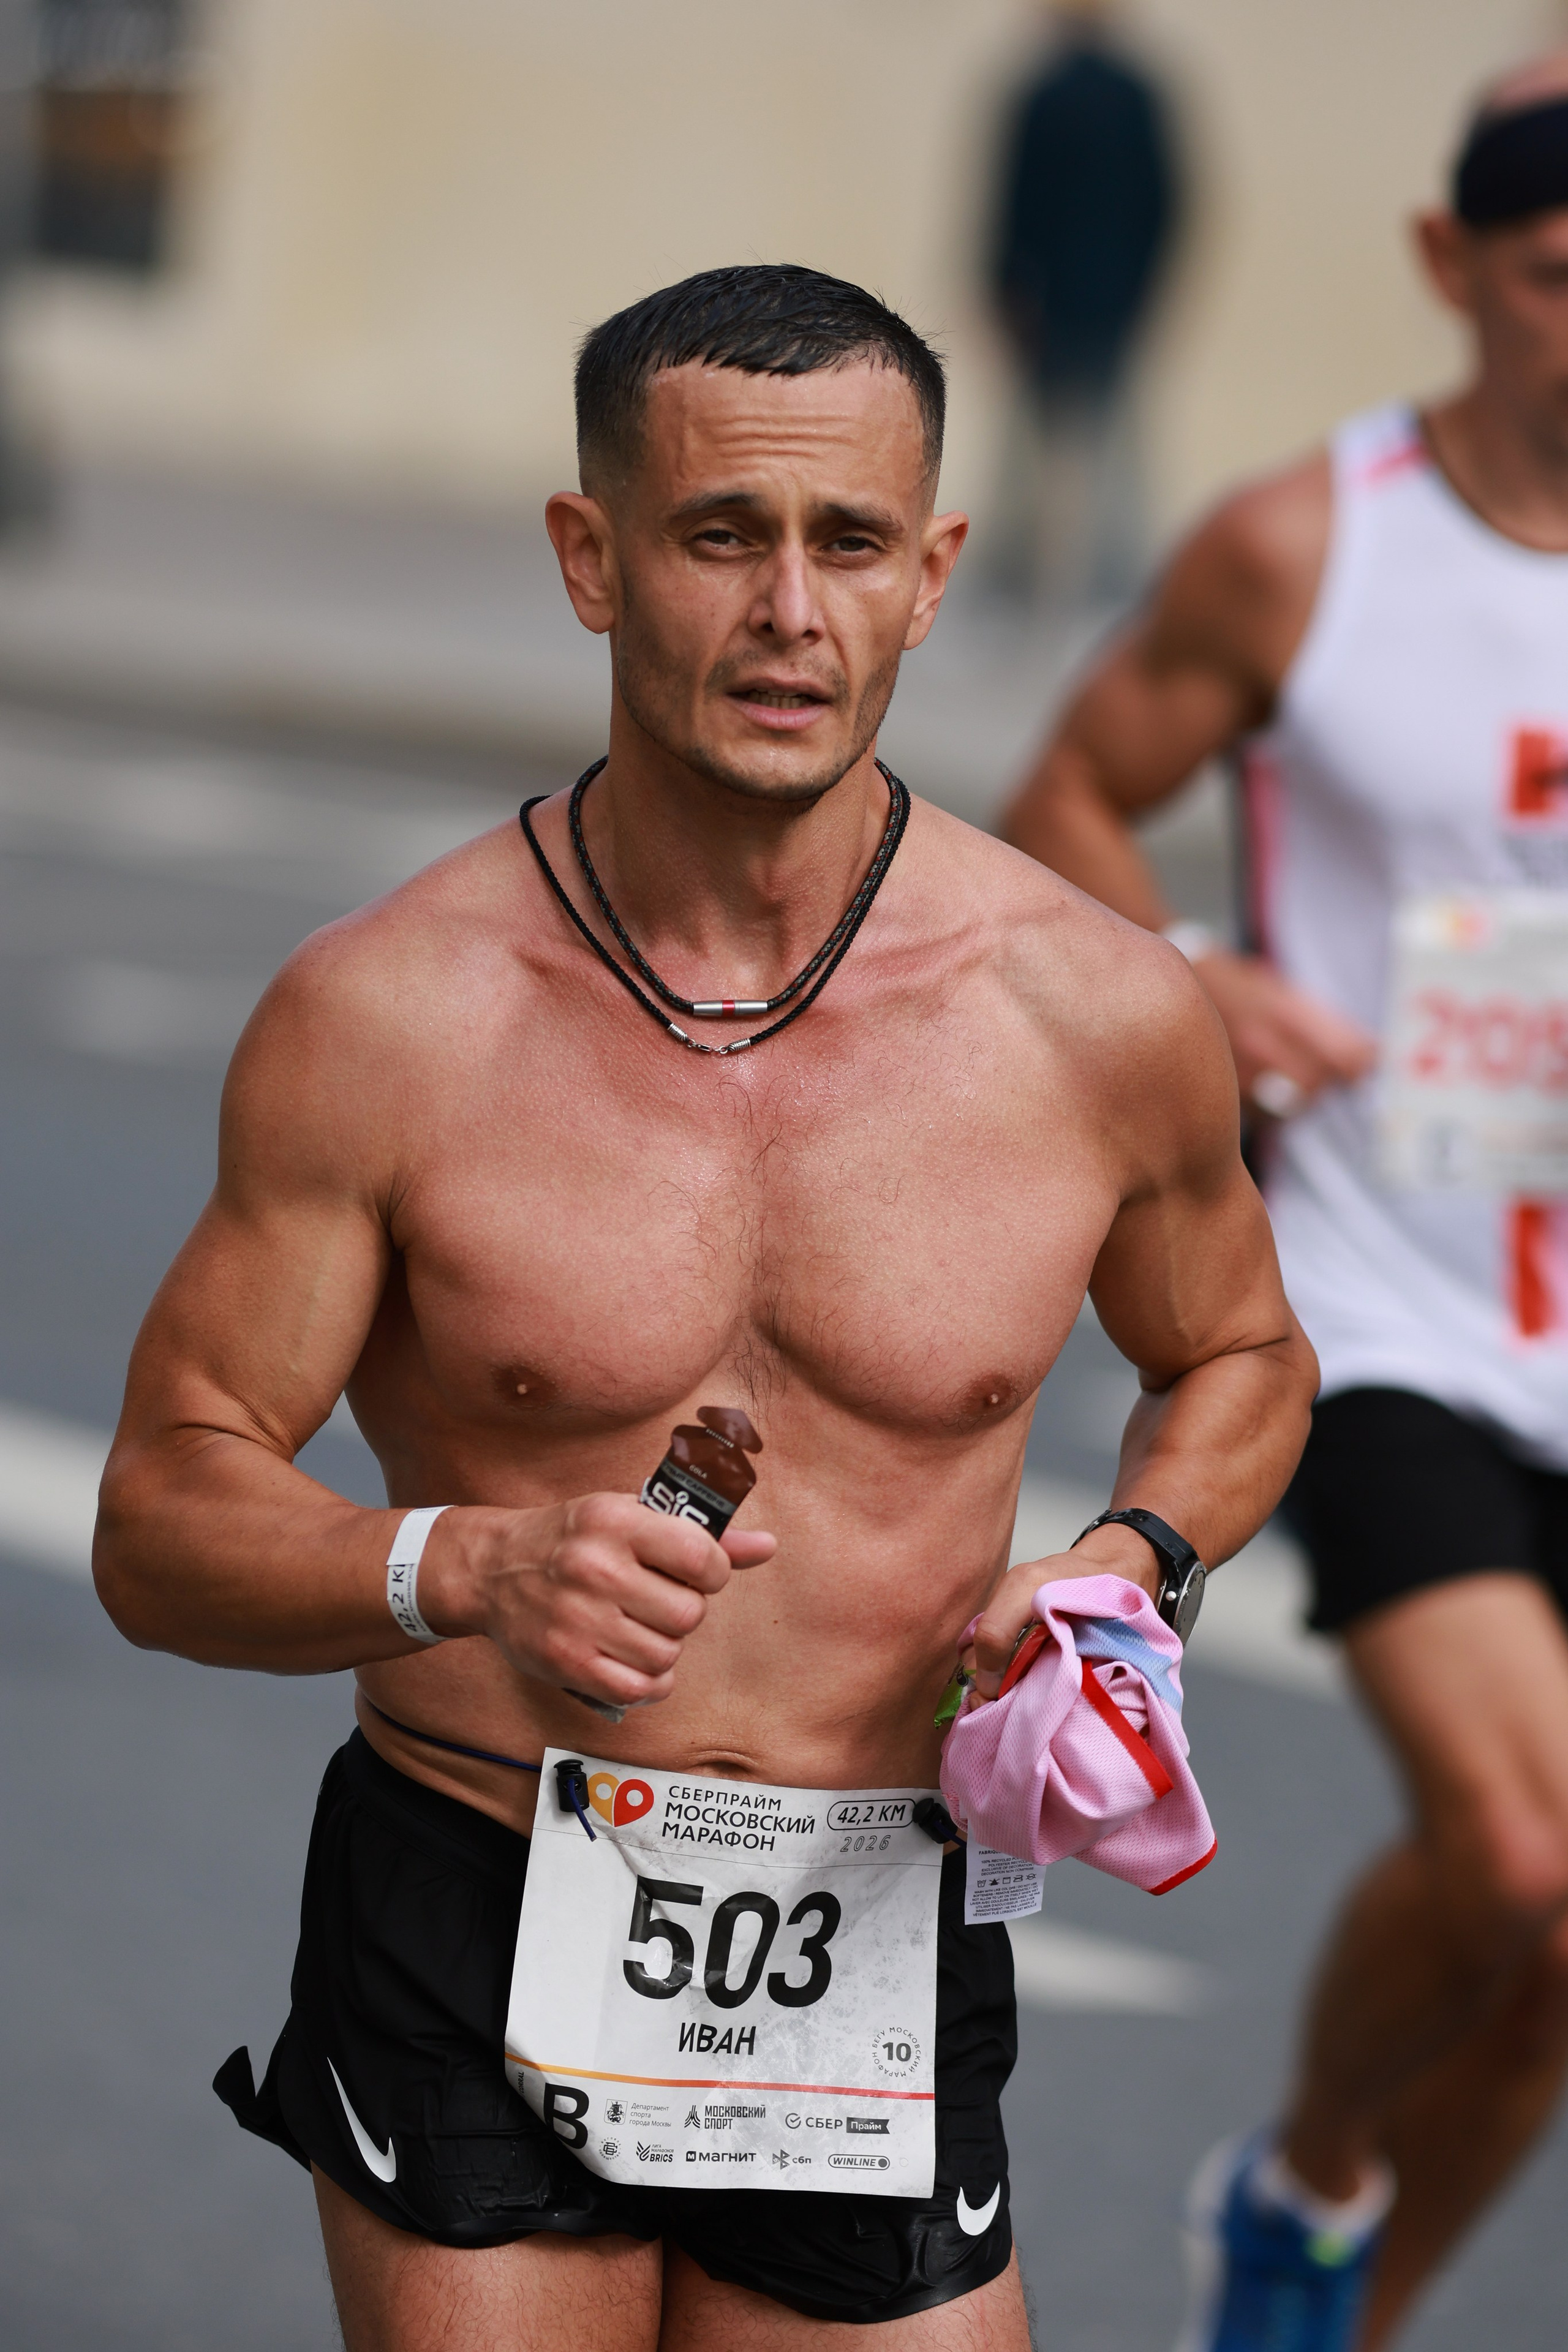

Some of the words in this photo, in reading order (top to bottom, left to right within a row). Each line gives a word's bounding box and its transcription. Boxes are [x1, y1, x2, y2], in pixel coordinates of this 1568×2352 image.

[689, 1464, 707, 1479] COLA
[392, 1564, 405, 1583] К
[669, 1785, 782, 1811] СБЕРПРАЙМ
[665, 1802, 815, 1834] МОСКОВСКИЙ
[837, 1806, 874, 1825] 42,2
[662, 1822, 775, 1851] МАРАФОН
[840, 1835, 891, 1852] 2026
[622, 1874, 842, 2009] 503
[678, 2022, 755, 2056] ИВАН
[872, 2030, 885, 2048] БЕГУ
[882, 2042, 911, 2062] 10
[889, 2027, 921, 2073] МОСКОВСКИЙ
[872, 2052, 906, 2077] МАРАФОН
[704, 2105, 766, 2118] МОСКОВСКИЙ
[704, 2118, 733, 2129] СПОРТ
[805, 2117, 843, 2129] СБЕР
[851, 2121, 882, 2132] Прайм
[650, 2154, 673, 2162] BRICS
[833, 2157, 876, 2166] WINLINE
